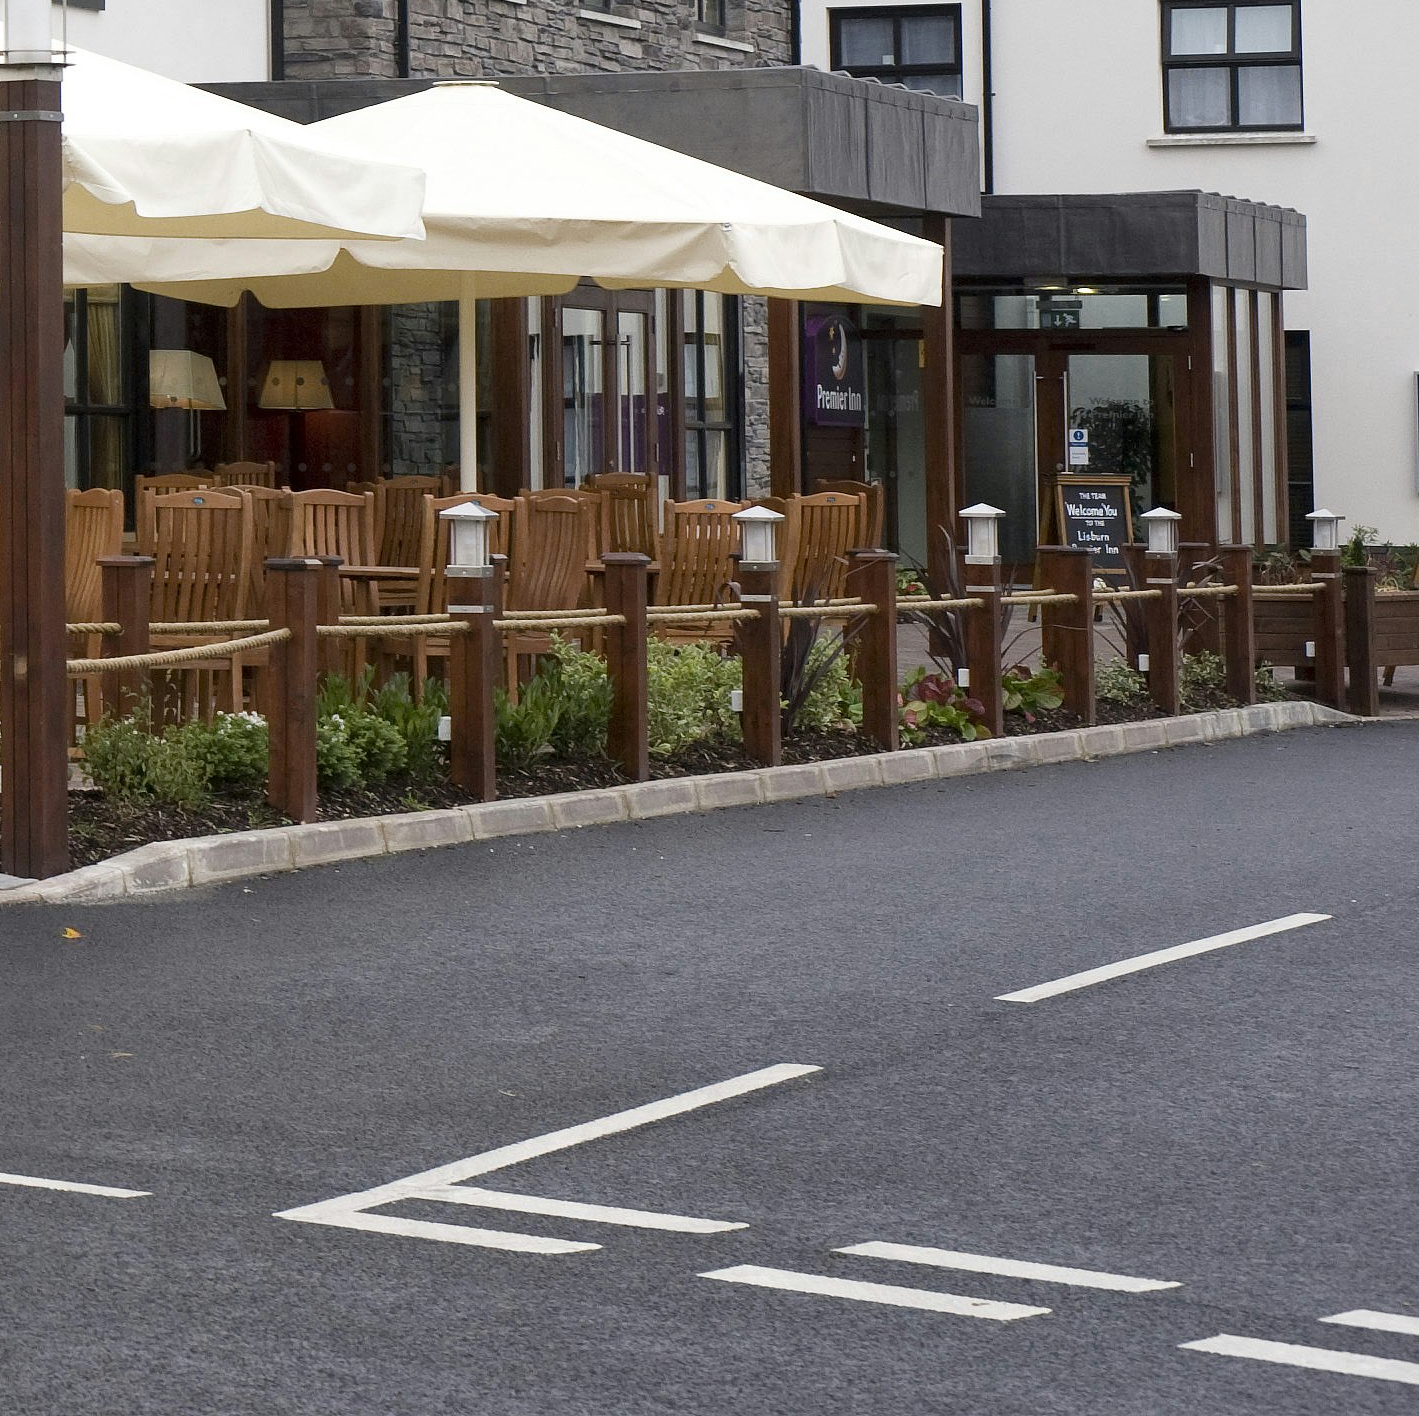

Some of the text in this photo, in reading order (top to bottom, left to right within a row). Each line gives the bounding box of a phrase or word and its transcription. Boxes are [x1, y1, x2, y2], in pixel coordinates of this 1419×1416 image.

[816, 384, 848, 411] Premier
[848, 387, 862, 412] Inn
[1065, 501, 1118, 517] Welcome You
[1077, 530, 1110, 542] Lisburn
[1105, 543, 1119, 554] Inn
